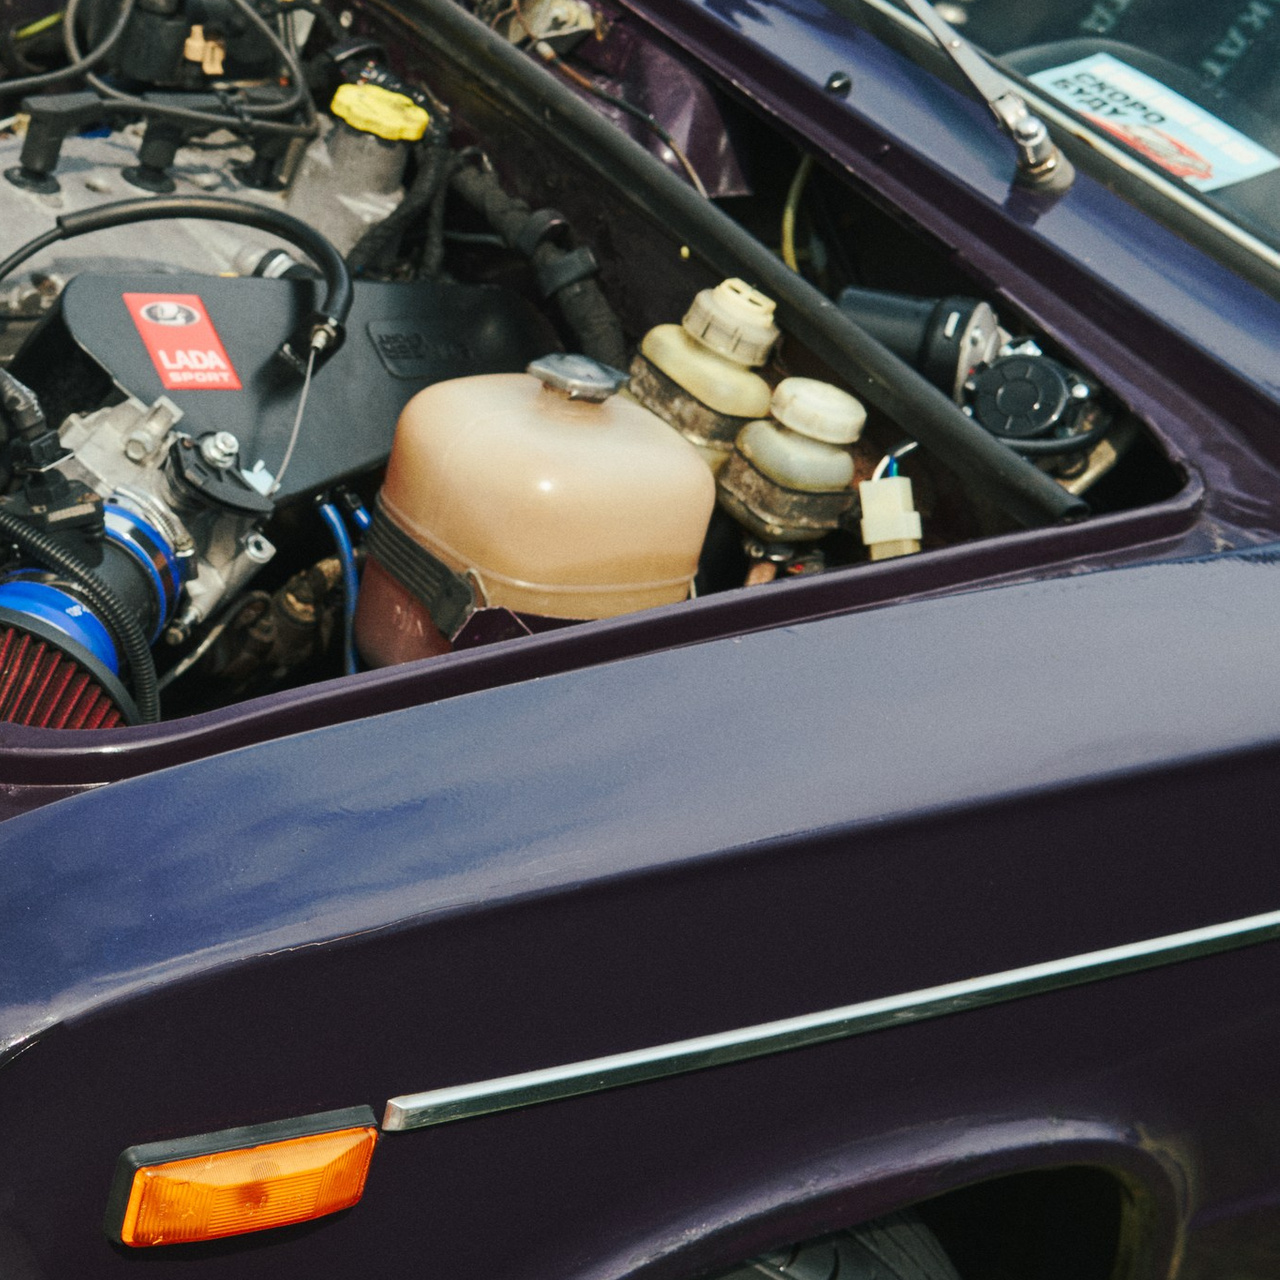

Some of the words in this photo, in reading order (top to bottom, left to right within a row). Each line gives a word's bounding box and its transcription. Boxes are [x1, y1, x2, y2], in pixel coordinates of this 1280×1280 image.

[1051, 78, 1128, 119] БУДУ
[1072, 72, 1166, 124] СКОРО
[158, 349, 226, 370] LADA
[168, 372, 231, 383] SPORT
